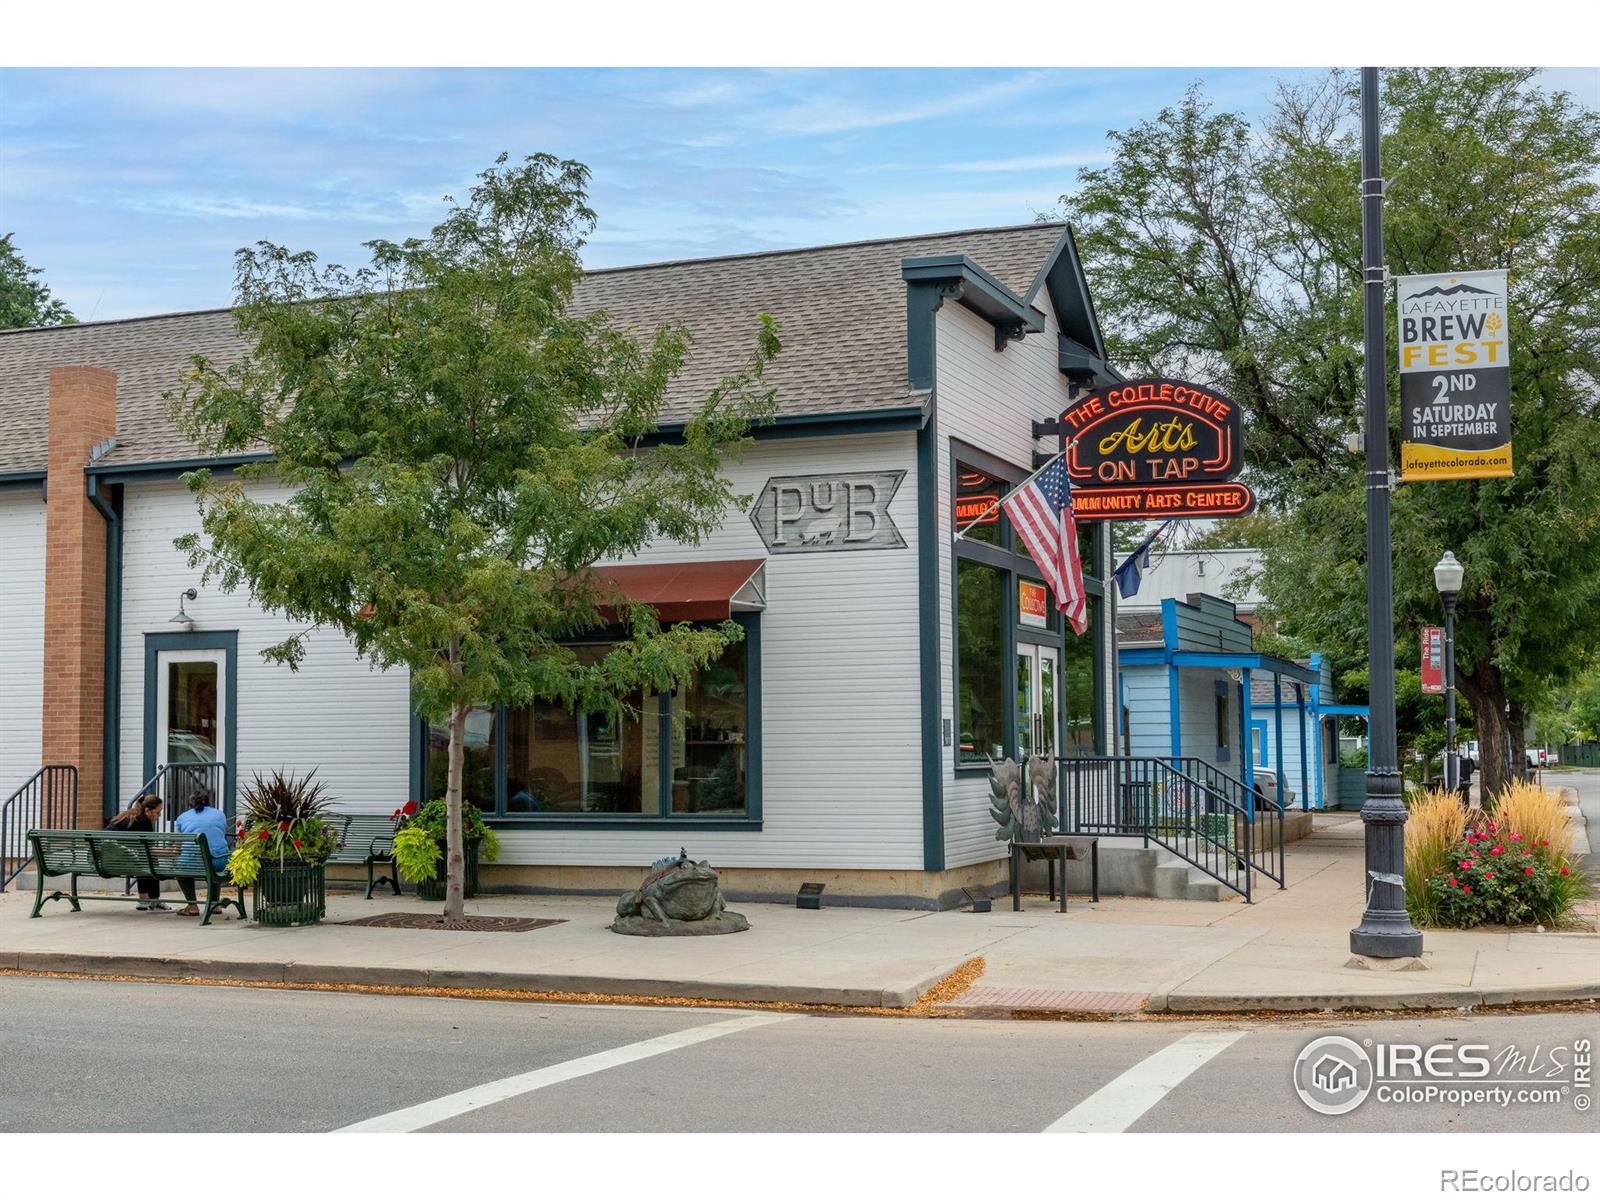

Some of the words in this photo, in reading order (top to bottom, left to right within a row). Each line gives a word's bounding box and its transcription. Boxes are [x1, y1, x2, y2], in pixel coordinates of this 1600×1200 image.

[1402, 297, 1503, 315] LAFAYETTE
[1403, 313, 1487, 343] BREW
[1403, 341, 1504, 368] FEST
[1064, 398, 1105, 429] THE
[1108, 384, 1231, 421] COLLECTIVE
[1413, 403, 1498, 424] SATURDAY
[1098, 416, 1199, 455] Arts
[1413, 426, 1429, 438] IN
[1431, 423, 1498, 438] SEPTEMBER
[1098, 459, 1136, 483] ON
[1146, 458, 1199, 480] TAP
[1406, 457, 1507, 471] lafayettecolorado.com
[1146, 493, 1182, 509] ARTS
[1187, 492, 1241, 507] CENTER
